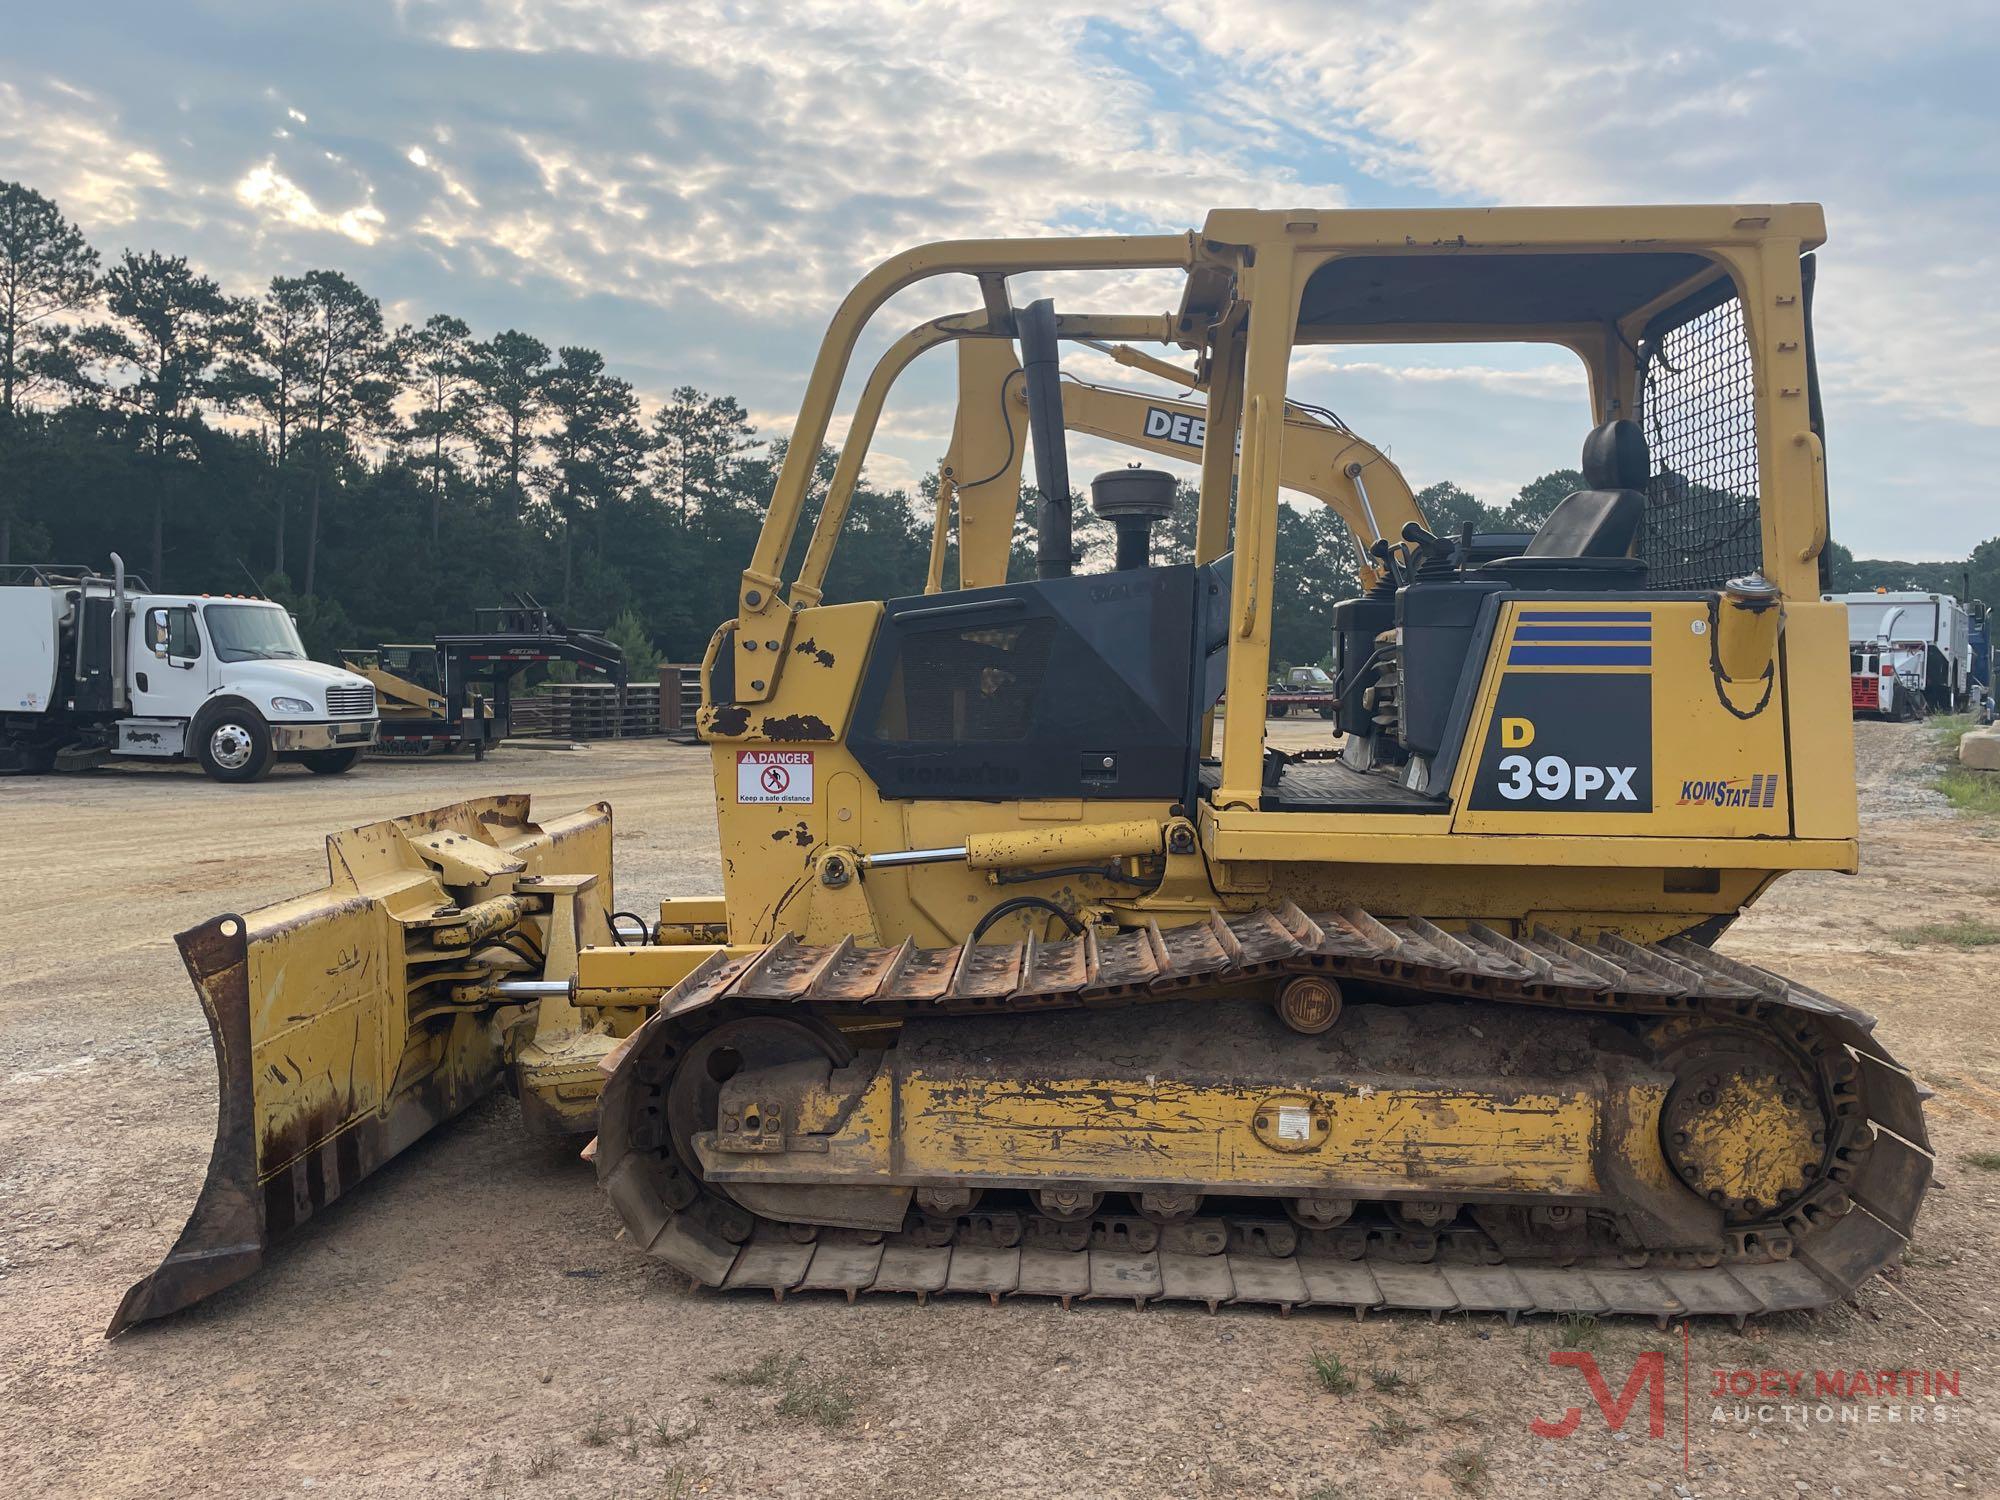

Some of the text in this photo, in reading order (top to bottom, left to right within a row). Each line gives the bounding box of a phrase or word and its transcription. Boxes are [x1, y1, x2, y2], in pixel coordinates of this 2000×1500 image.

[1501, 717, 1535, 749] D
[758, 752, 810, 764] DANGER
[1497, 754, 1638, 801] 39PX
[740, 795, 758, 803] Keep
